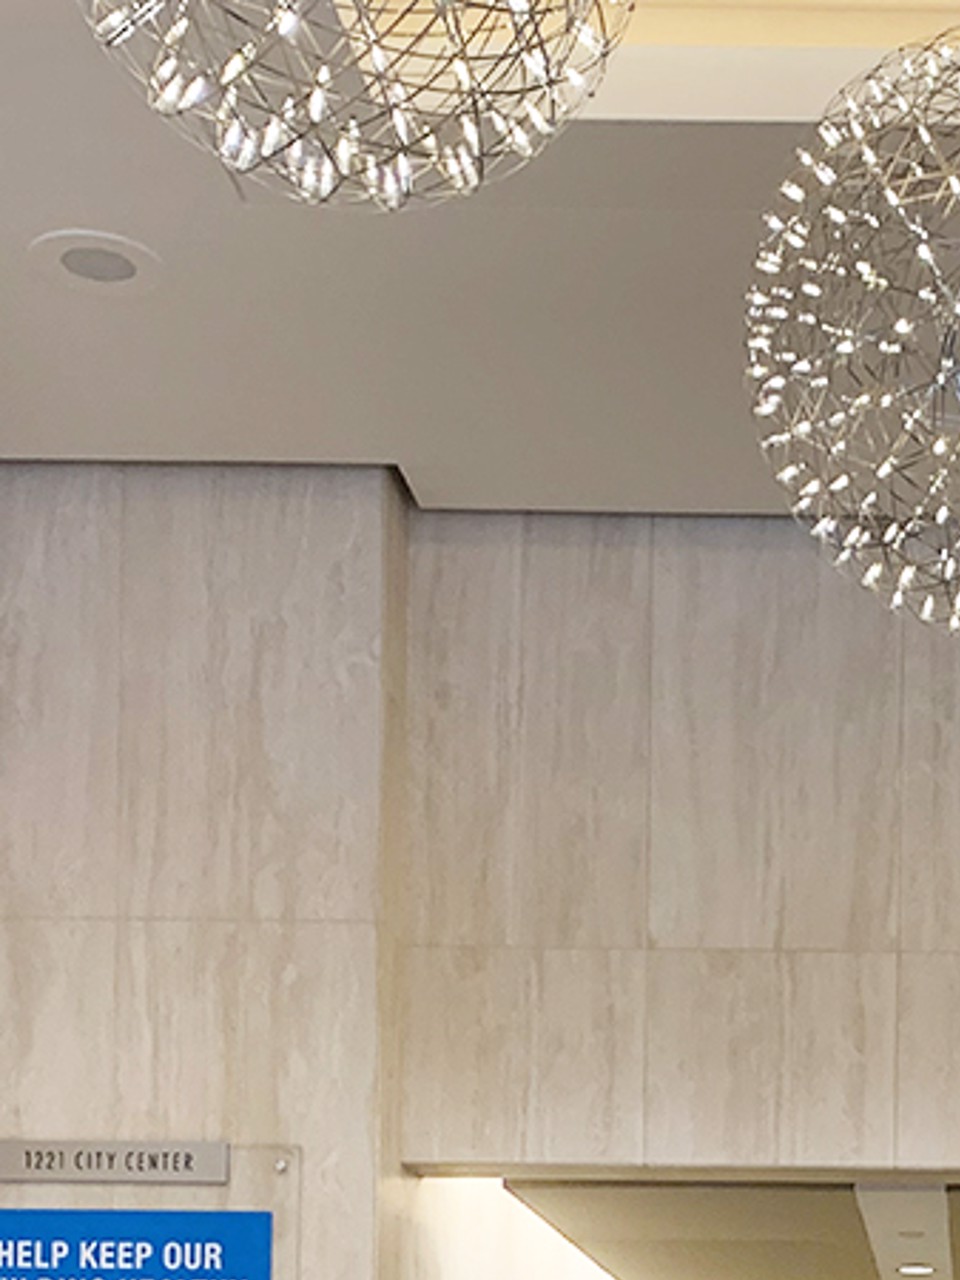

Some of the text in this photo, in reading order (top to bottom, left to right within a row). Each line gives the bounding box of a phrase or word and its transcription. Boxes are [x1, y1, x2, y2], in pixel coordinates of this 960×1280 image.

[25, 1151, 195, 1172] 1221 CITY CENTER
[0, 1240, 222, 1270] HELP KEEP OUR
